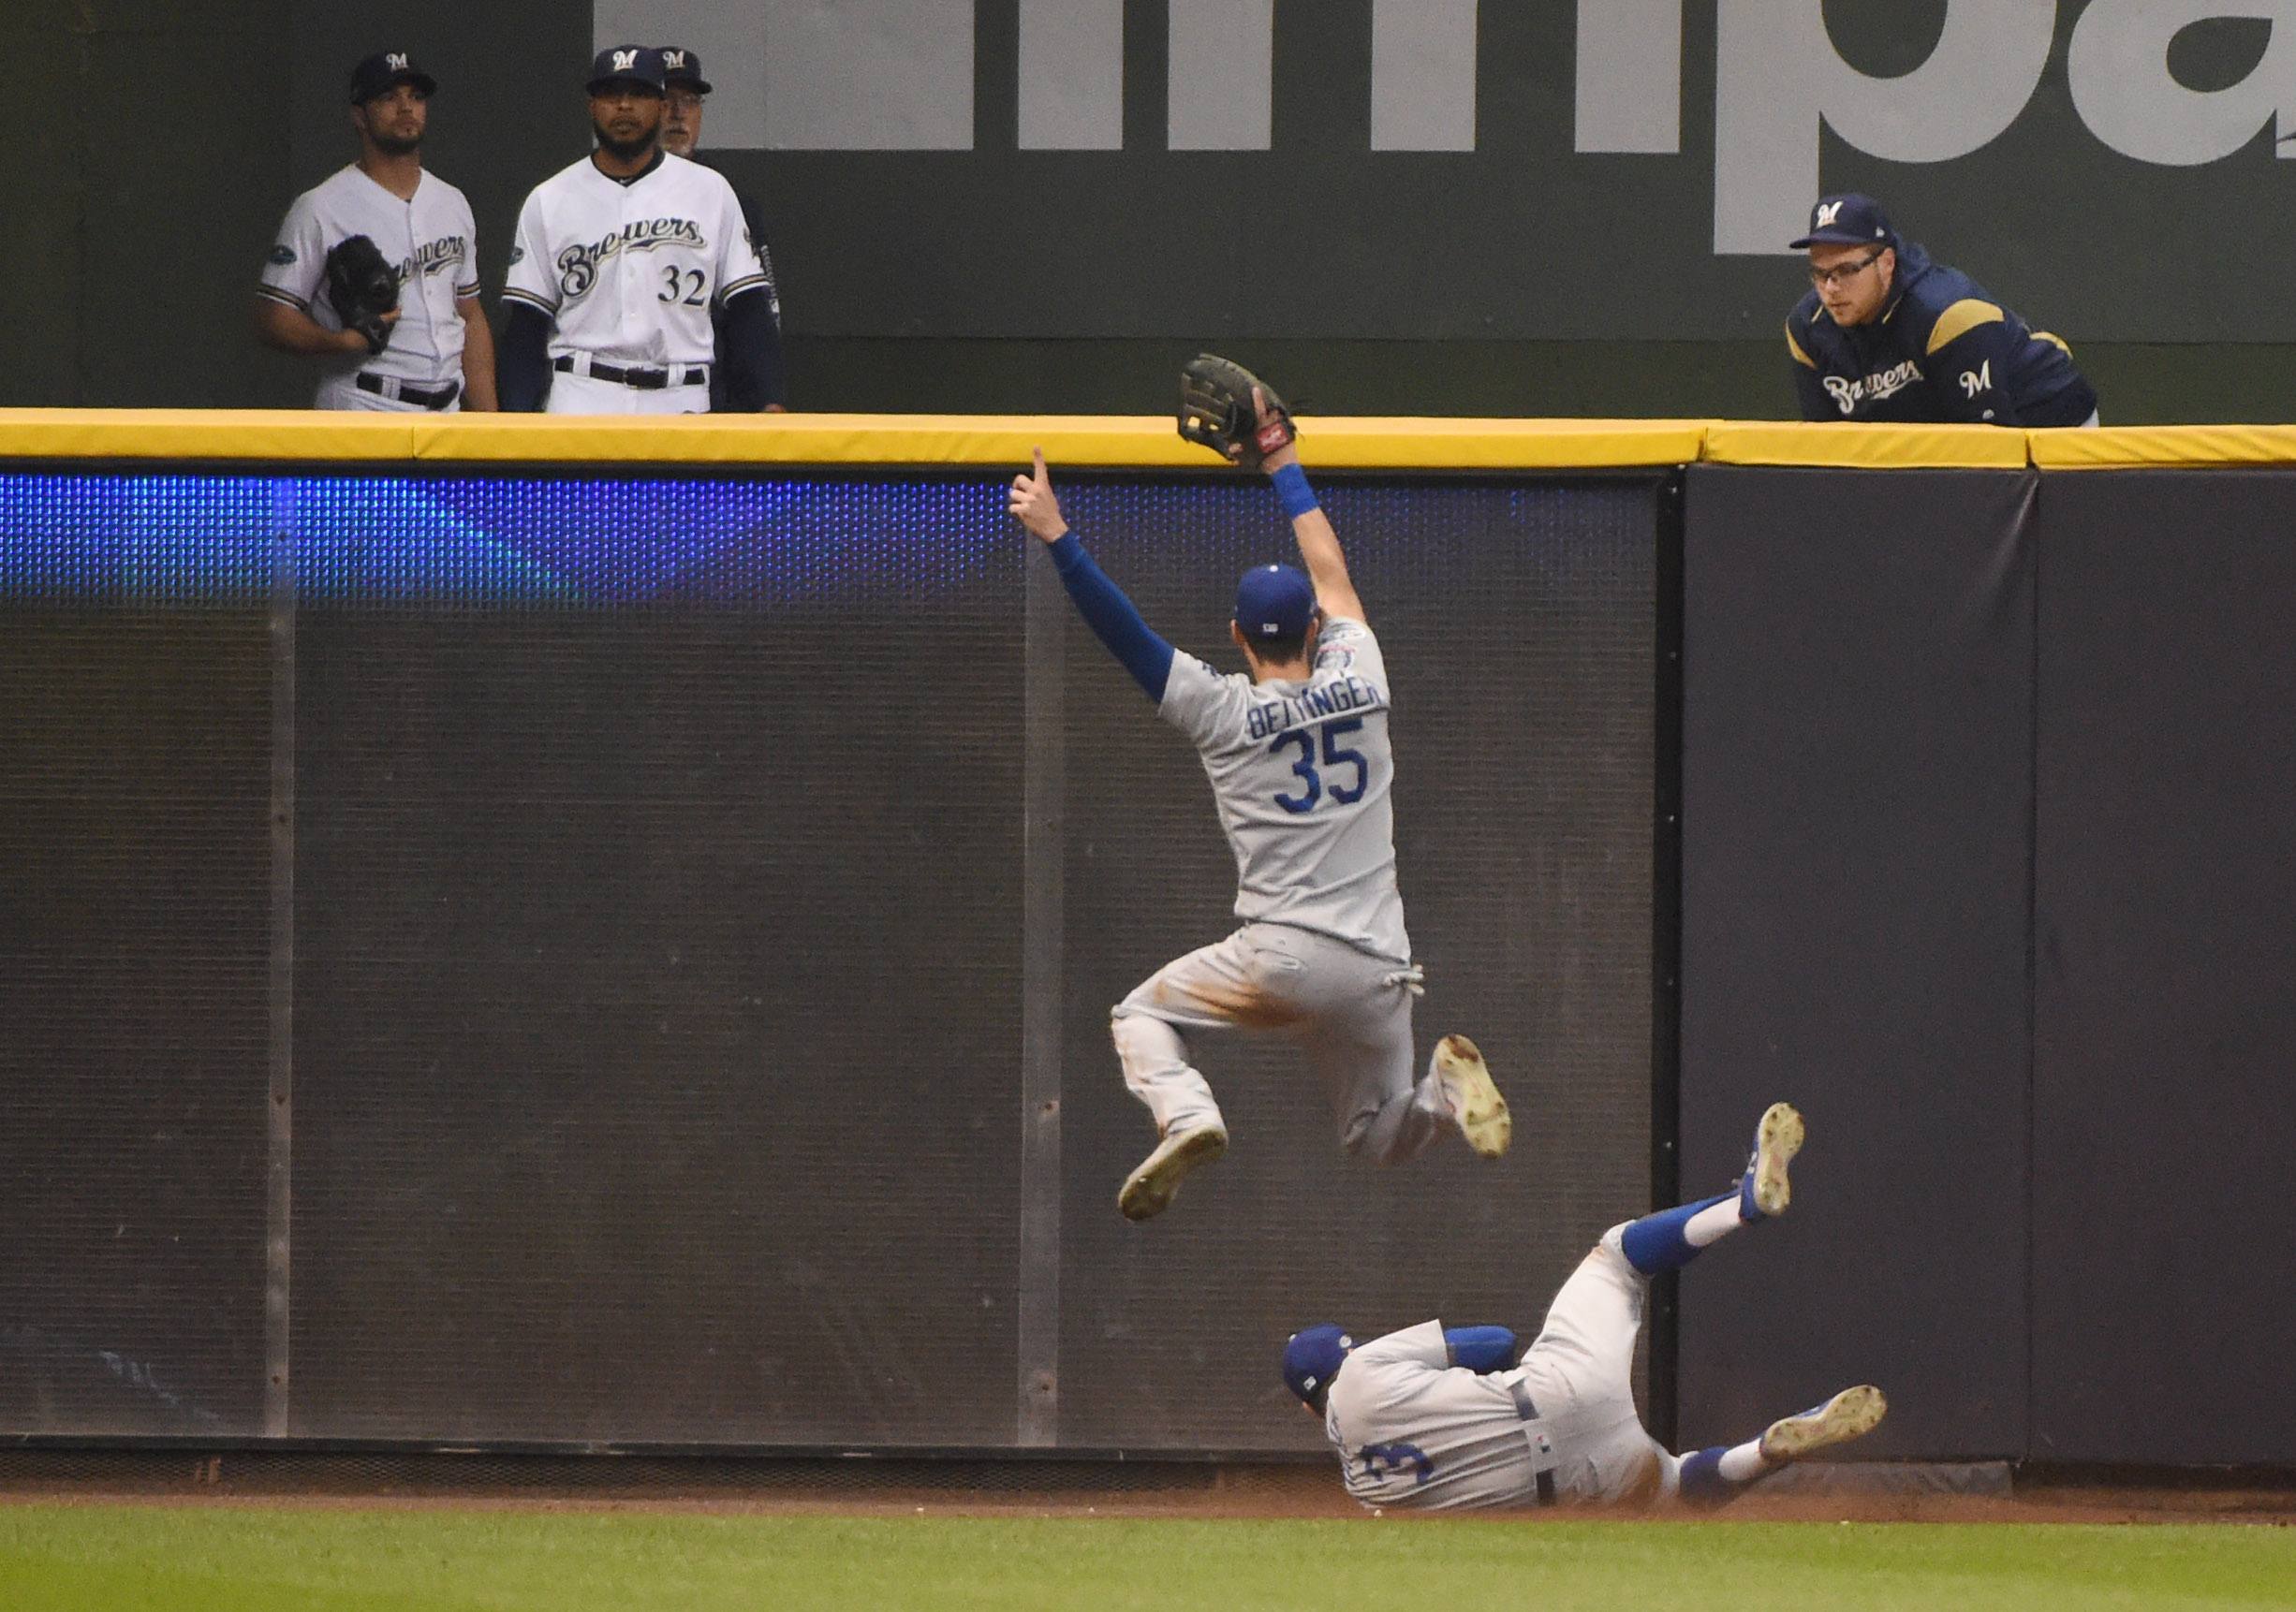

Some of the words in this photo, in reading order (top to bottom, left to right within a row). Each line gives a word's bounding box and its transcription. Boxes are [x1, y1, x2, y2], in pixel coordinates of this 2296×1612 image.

[386, 52, 408, 72] M
[612, 49, 638, 71] M
[663, 50, 685, 70] M
[1816, 200, 1844, 229] M
[393, 236, 466, 286] ewers
[557, 216, 708, 299] Brewers
[657, 264, 707, 308] 32
[1822, 359, 1924, 414] Brwers
[1959, 358, 1993, 399] M
[1269, 717, 1368, 813] 35
